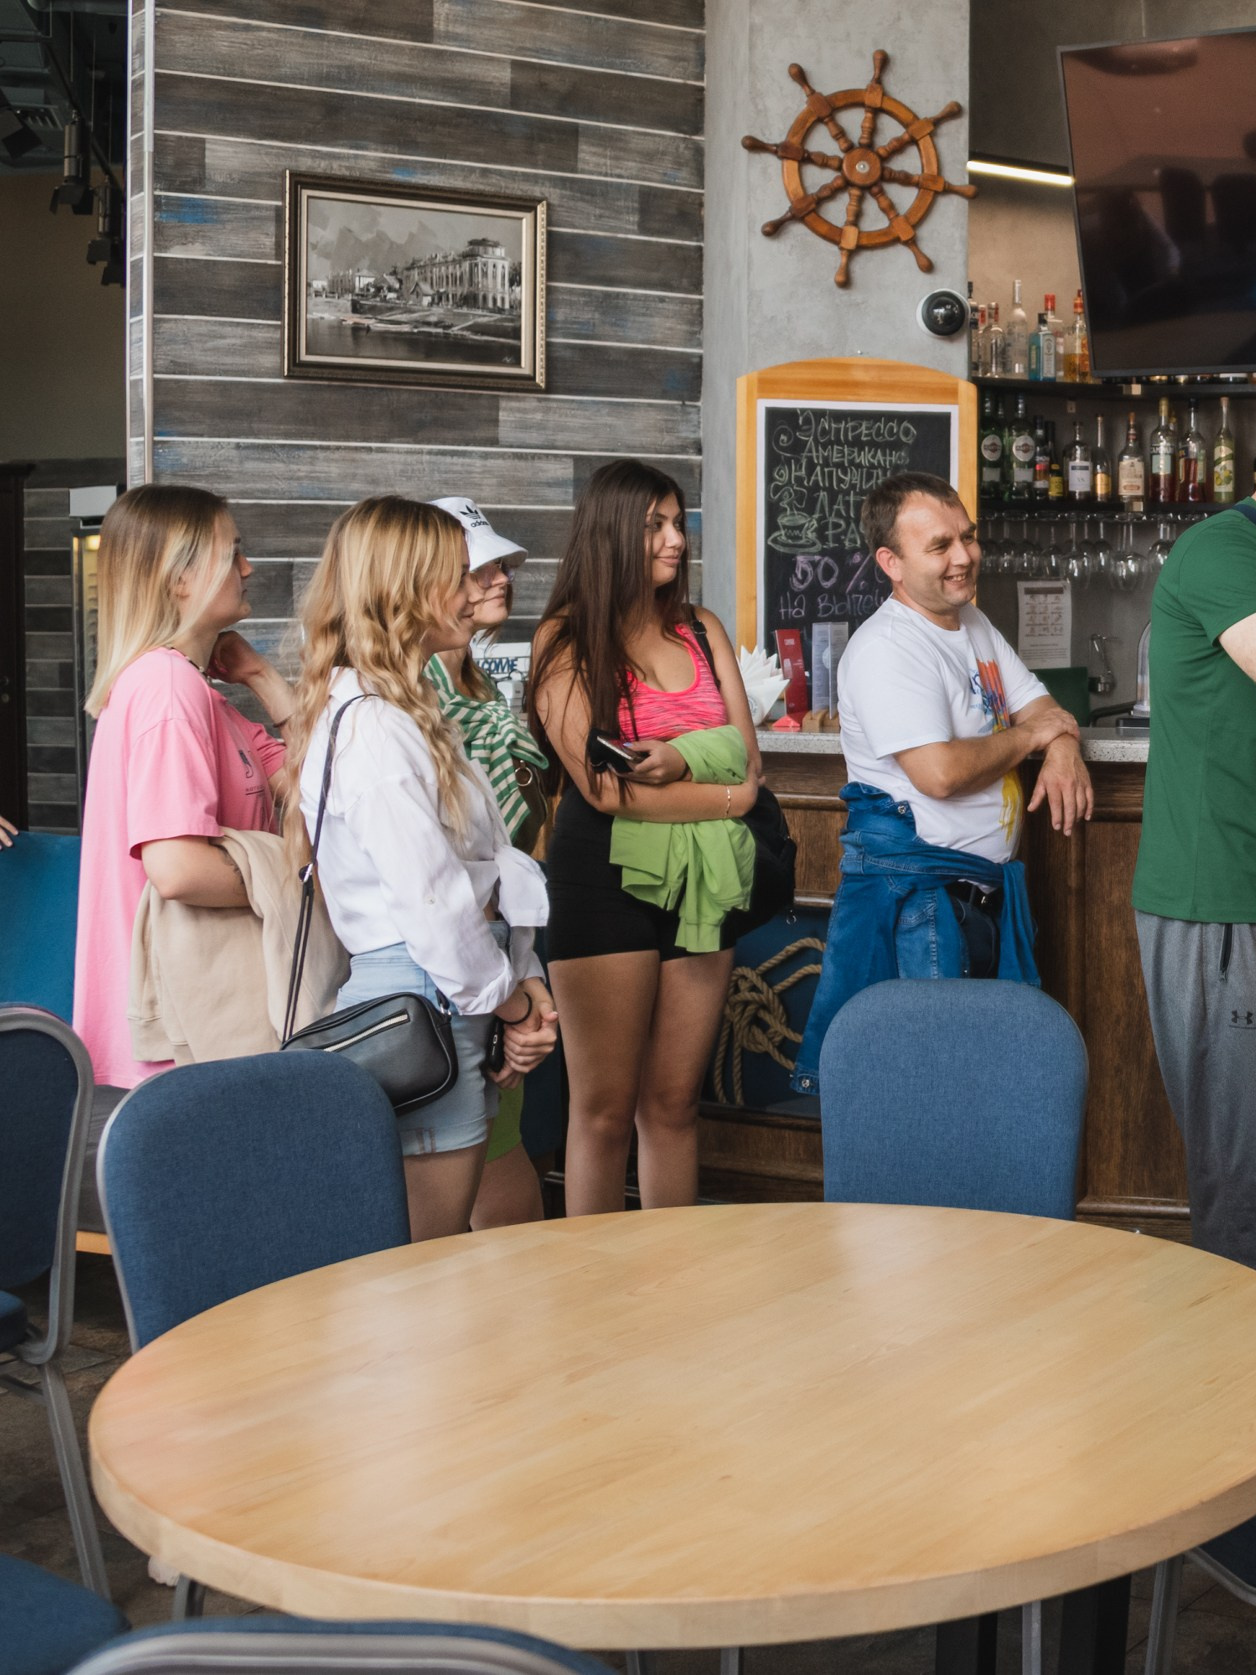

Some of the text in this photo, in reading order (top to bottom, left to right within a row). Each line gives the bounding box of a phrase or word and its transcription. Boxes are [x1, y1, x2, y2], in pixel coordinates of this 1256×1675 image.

[790, 458, 893, 492] КАПУЧИН
[813, 490, 867, 519] ЛАТ
[820, 516, 866, 549] РА
